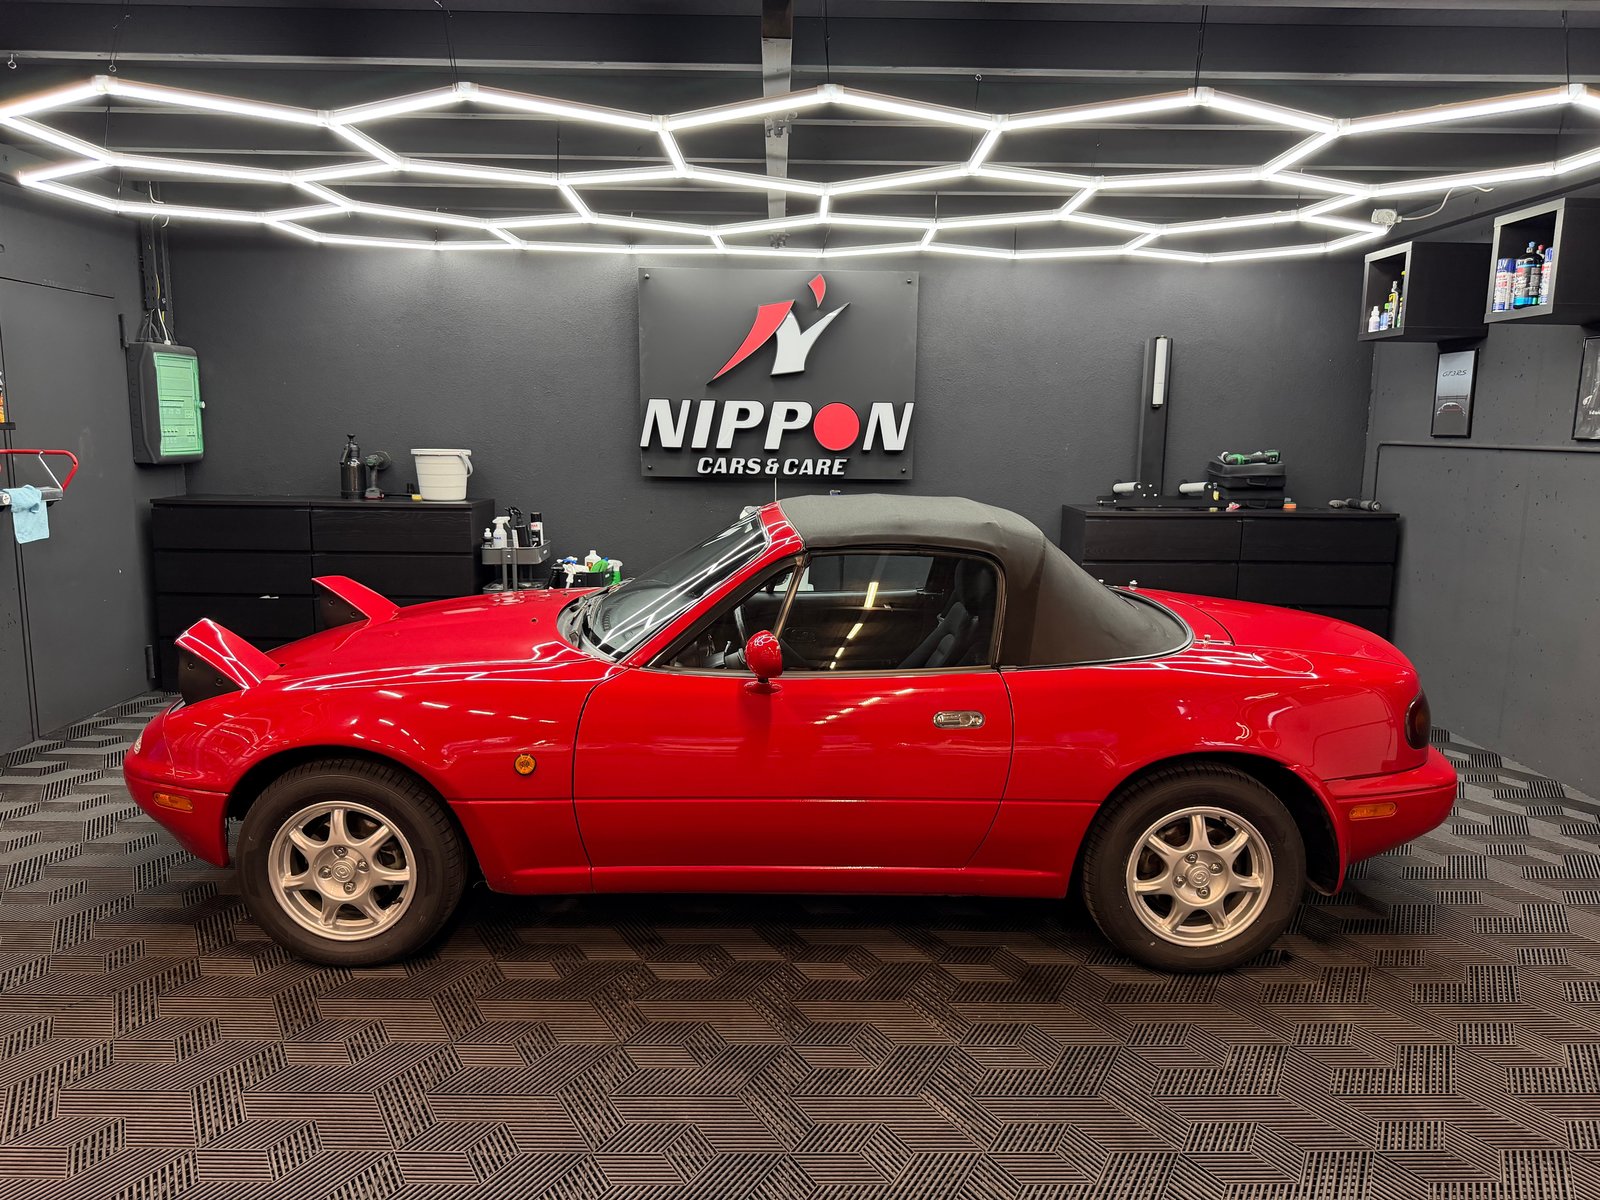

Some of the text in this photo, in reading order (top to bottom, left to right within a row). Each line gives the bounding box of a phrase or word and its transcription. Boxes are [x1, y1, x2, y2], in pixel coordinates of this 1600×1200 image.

[640, 398, 914, 451] NIPPON
[697, 457, 761, 475] CARS
[783, 458, 849, 476] CARE
